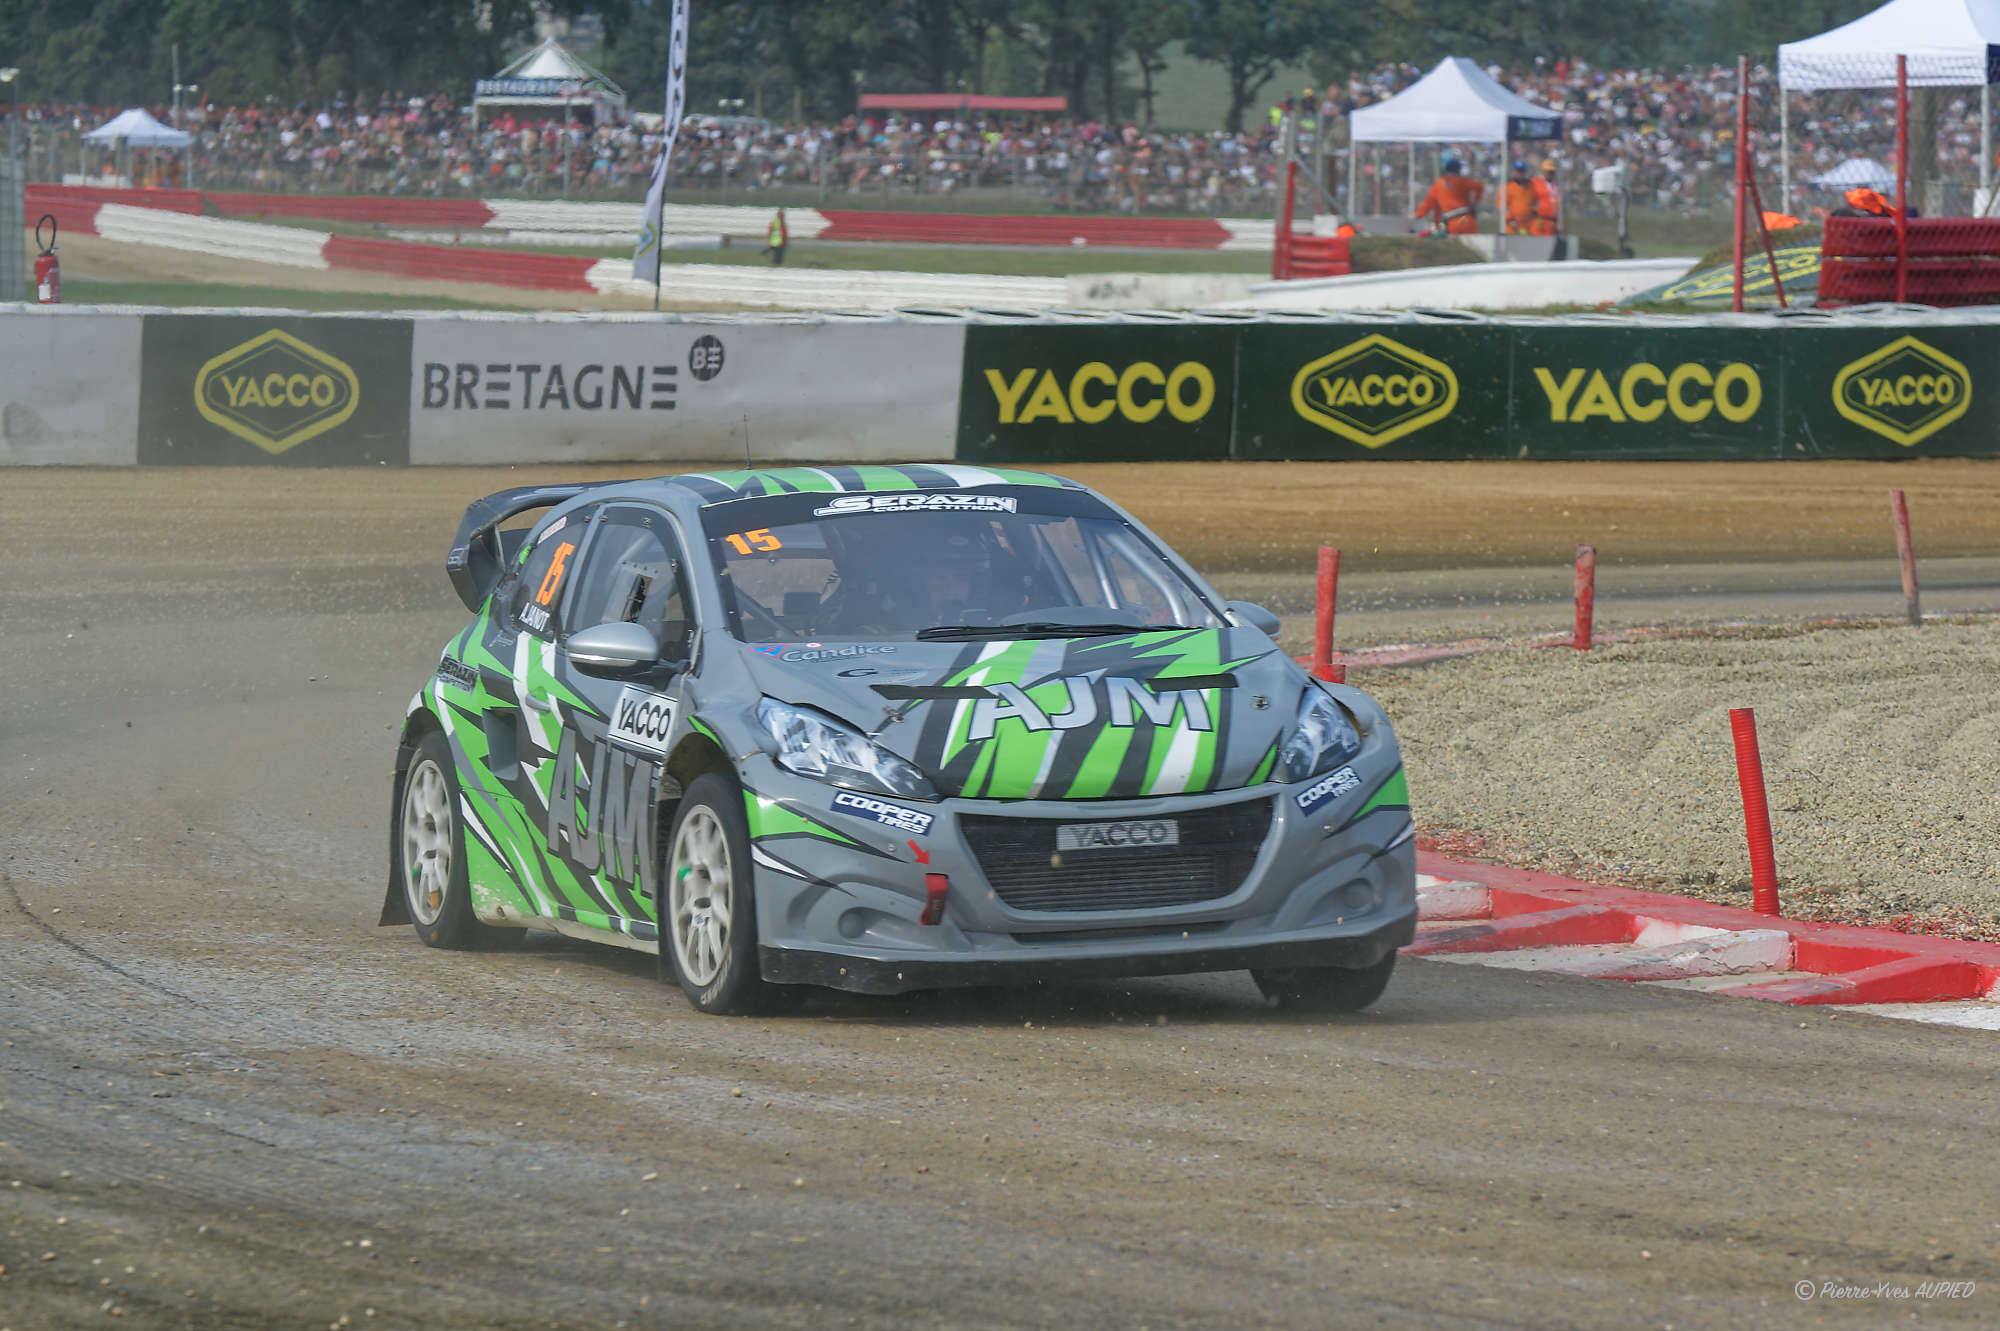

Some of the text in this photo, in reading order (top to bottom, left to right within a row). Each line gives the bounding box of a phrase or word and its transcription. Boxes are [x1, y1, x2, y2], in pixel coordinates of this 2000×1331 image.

[221, 373, 336, 408] YACCO
[423, 363, 679, 410] BRETAGNE
[984, 361, 1215, 425] YACCO
[1319, 374, 1434, 407] YACCO
[1534, 362, 1763, 424] YACCO
[1858, 374, 1955, 407] YACCO
[814, 494, 1017, 516] SERAZIN
[872, 505, 1001, 513] COMPETITION
[725, 528, 782, 555] 15
[536, 541, 576, 606] 15
[780, 644, 896, 663] Candice
[618, 697, 671, 742] YACCO
[967, 675, 1213, 743] AJM
[1297, 767, 1357, 807] COOPER
[1331, 776, 1361, 797] TIRES
[548, 726, 656, 898] AJM
[834, 793, 934, 827] COOPER
[877, 813, 929, 836] TIRES
[1068, 822, 1168, 847] YACCO
